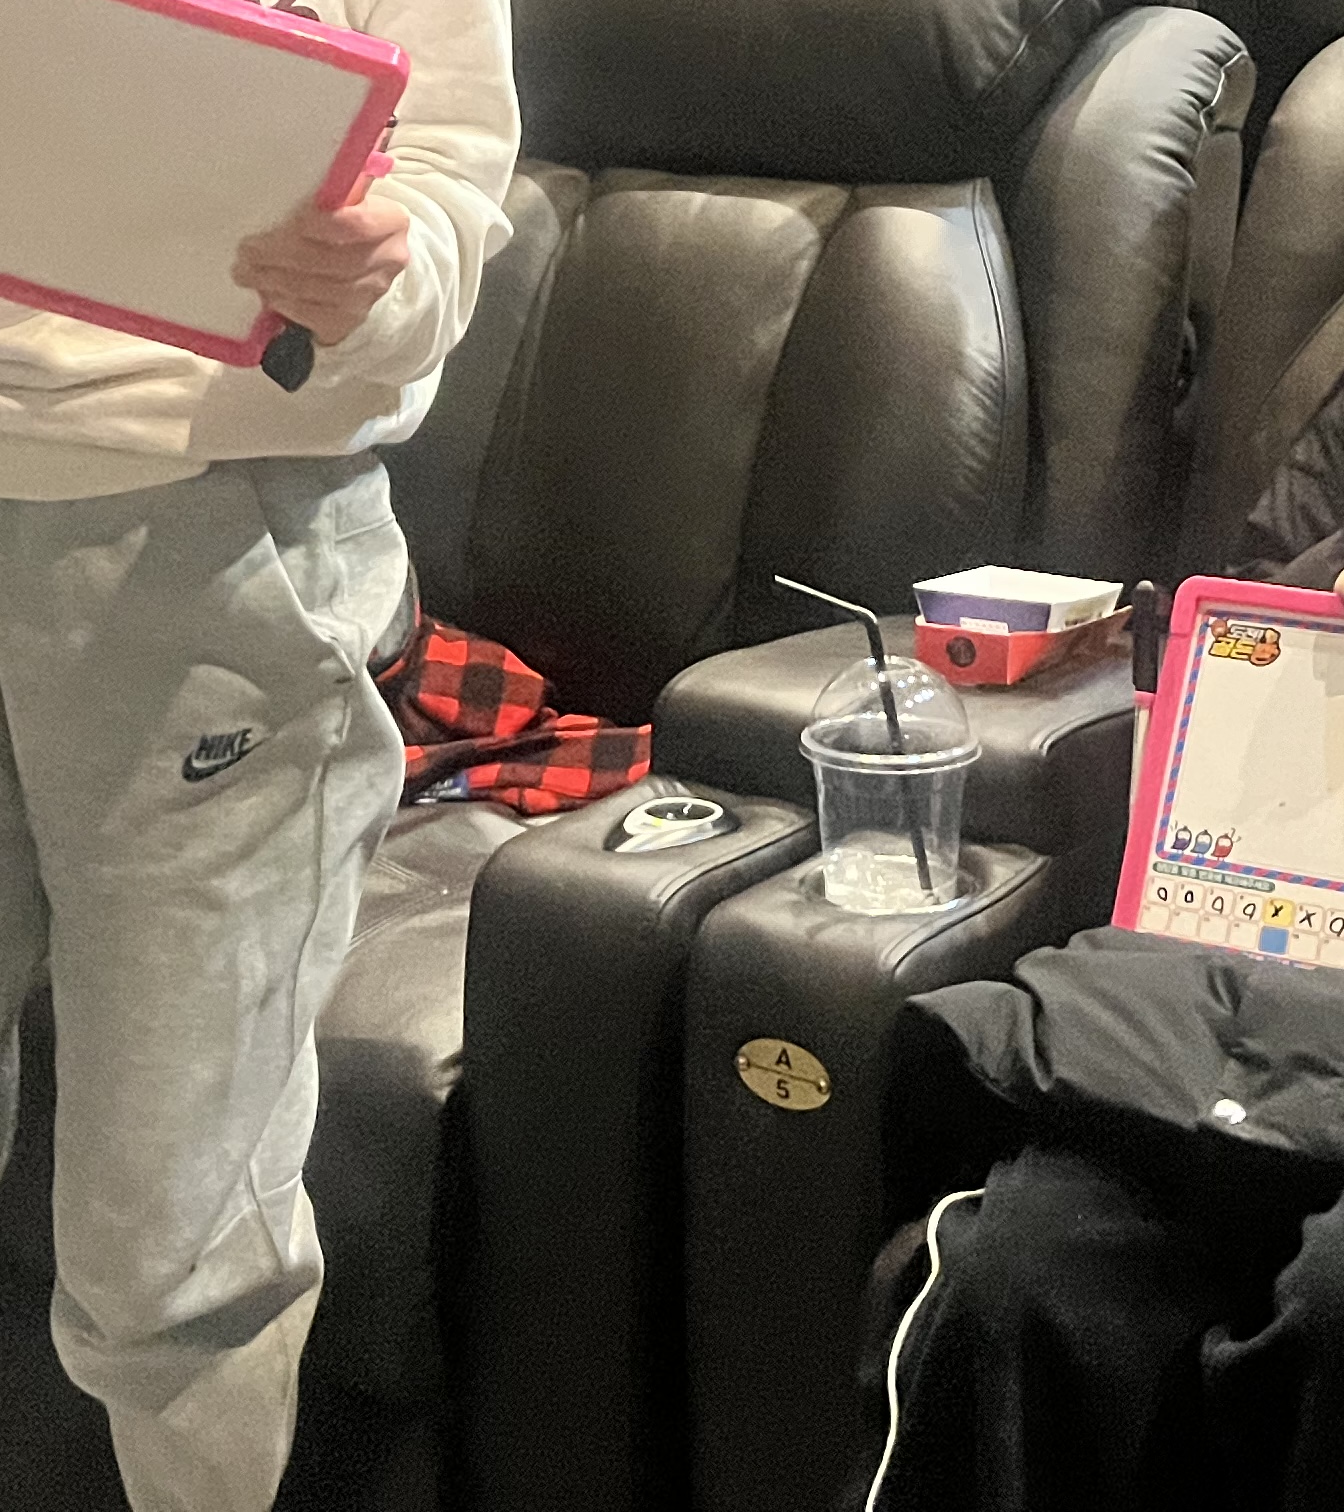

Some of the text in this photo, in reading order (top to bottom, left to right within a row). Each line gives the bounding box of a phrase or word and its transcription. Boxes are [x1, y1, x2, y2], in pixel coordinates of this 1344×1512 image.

[194, 727, 253, 761] NIKE
[775, 1047, 792, 1070] A
[776, 1078, 790, 1099] 5
